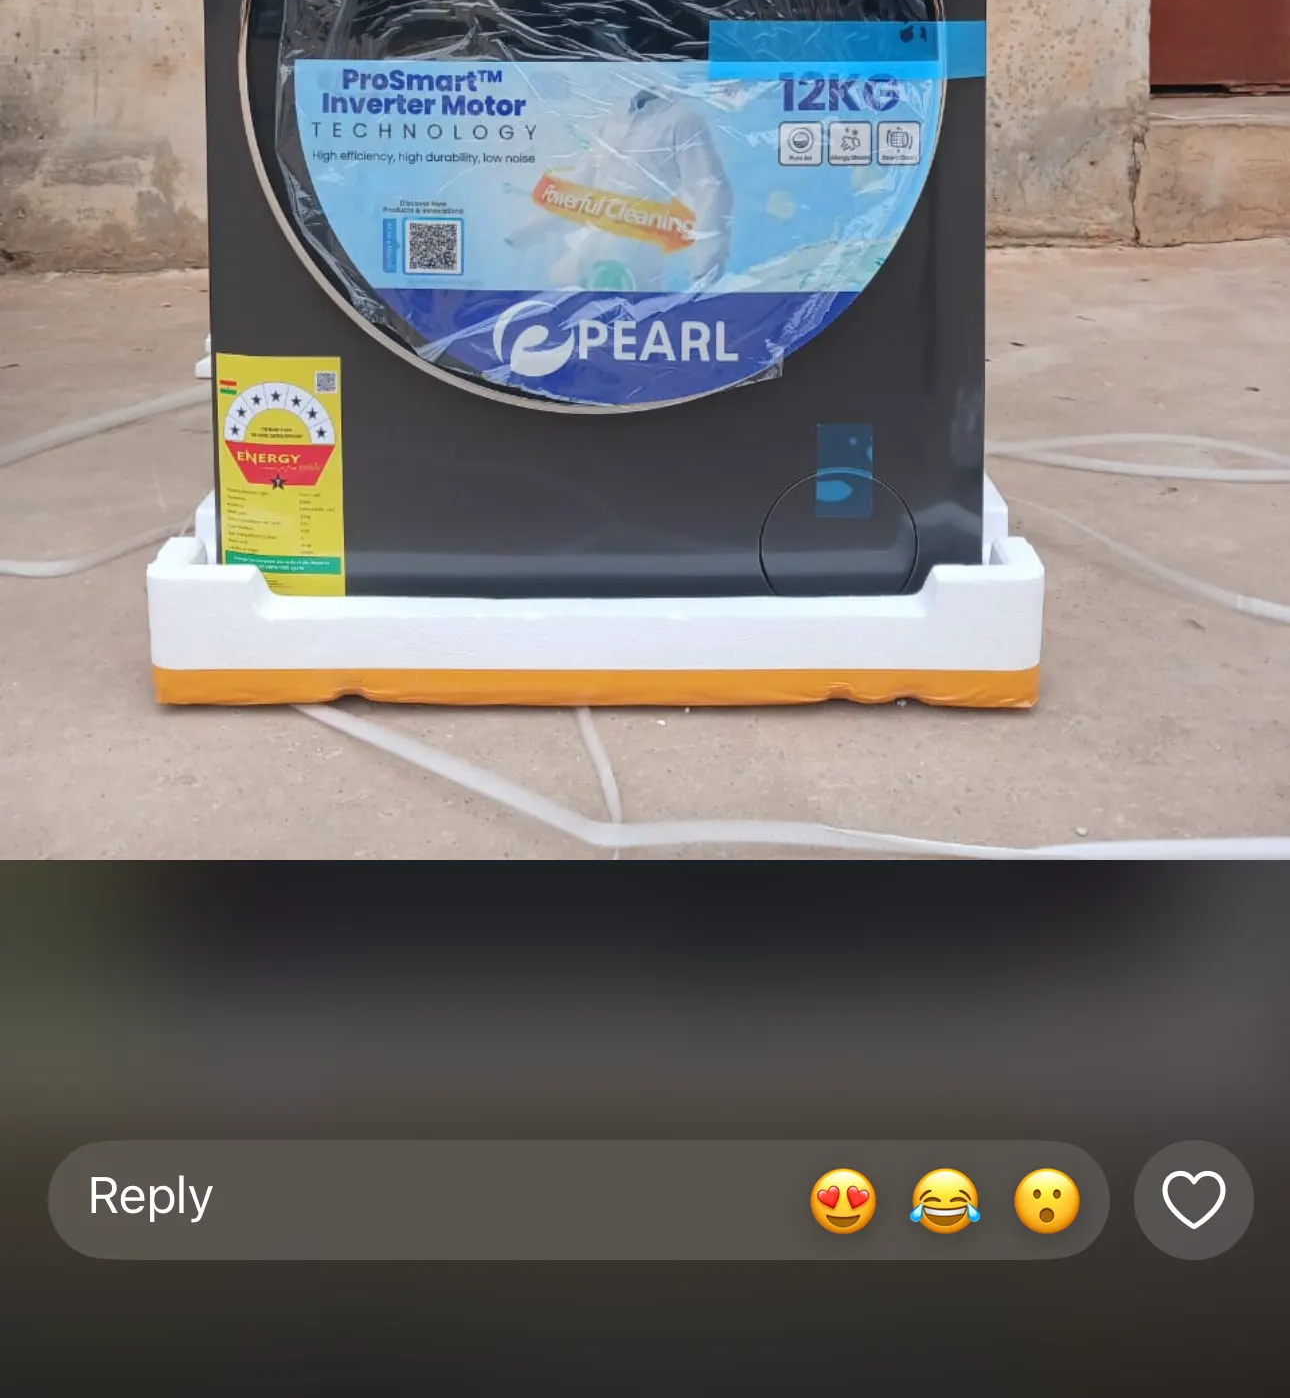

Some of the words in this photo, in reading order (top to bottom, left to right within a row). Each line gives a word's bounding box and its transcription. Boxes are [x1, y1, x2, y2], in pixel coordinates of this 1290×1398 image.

[778, 71, 901, 112] 12KG
[321, 92, 437, 116] Inverter
[441, 94, 527, 117] Motor
[311, 121, 537, 141] TECHNOLOGY
[312, 150, 337, 163] High
[339, 150, 397, 164] efficiency,
[398, 151, 424, 165] high
[425, 152, 481, 165] durability,
[482, 152, 502, 163] low
[505, 152, 536, 163] noise
[540, 183, 604, 218] Powerful
[605, 197, 696, 242] Cleaning
[578, 319, 740, 362] PEARL
[236, 450, 302, 466] ENERGY
